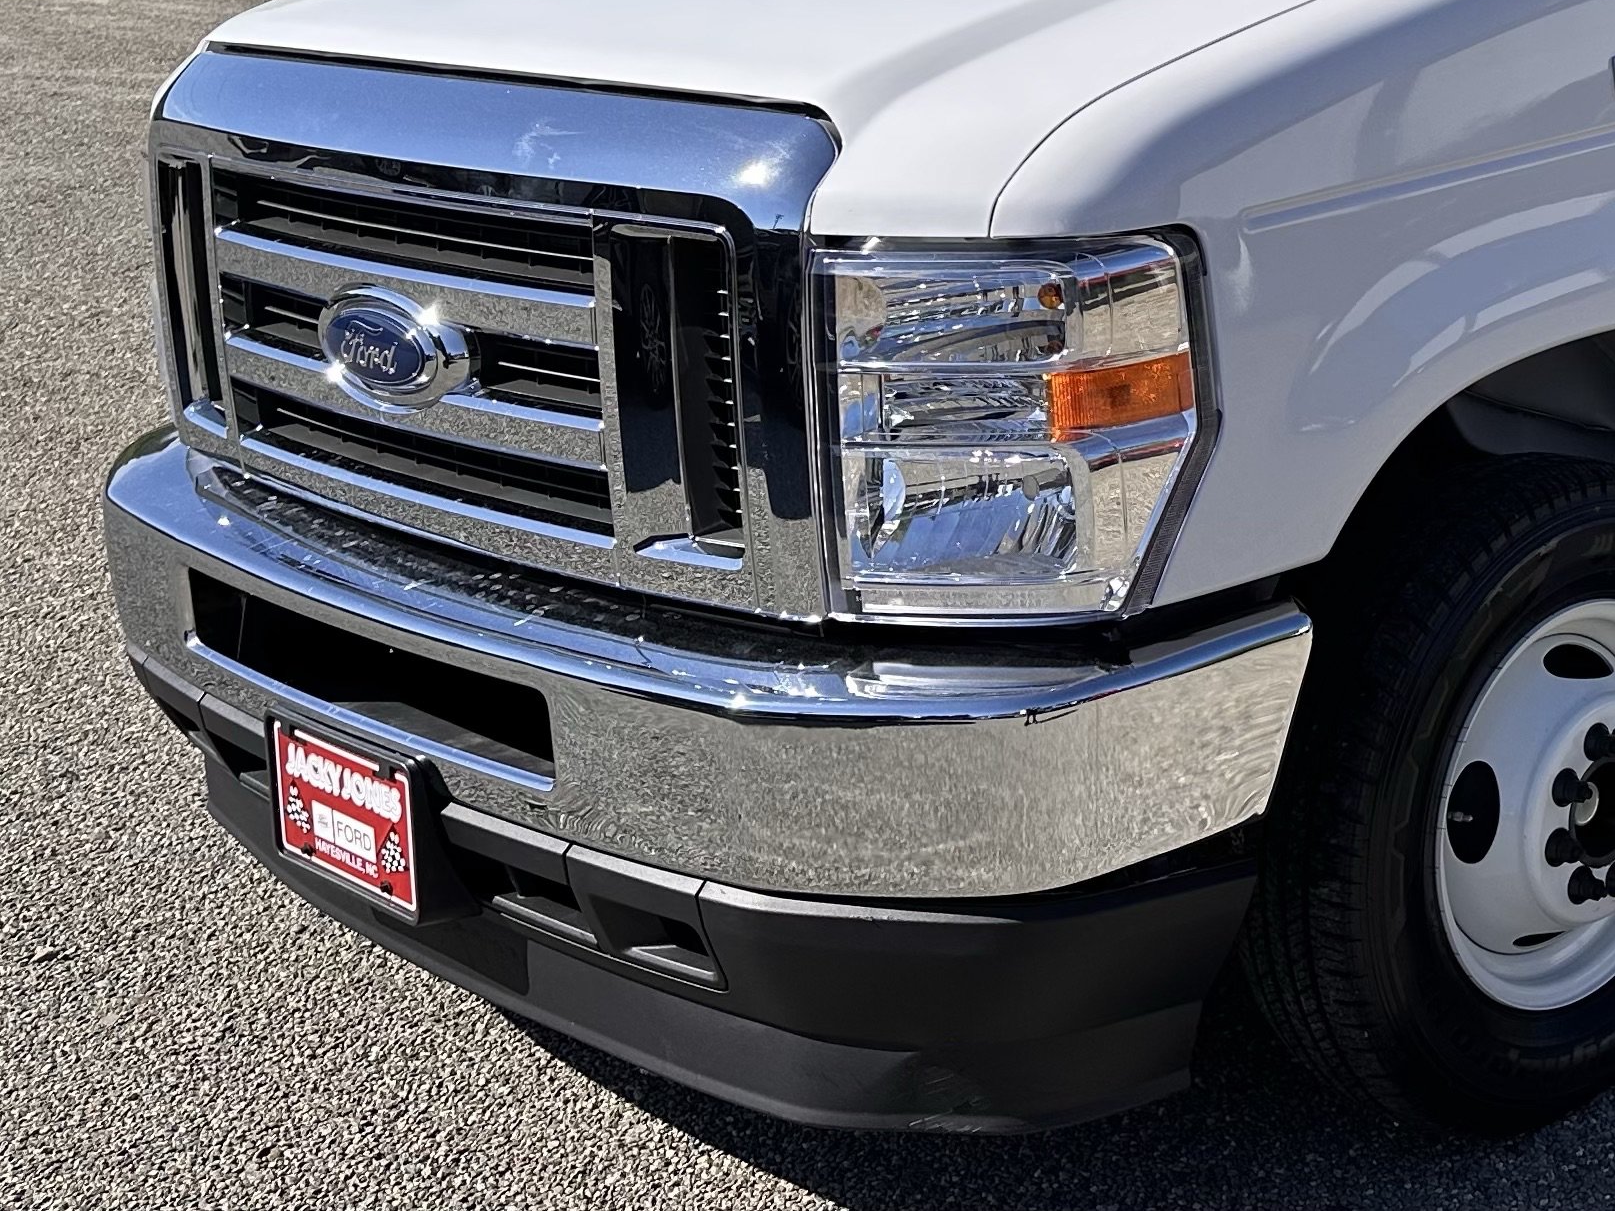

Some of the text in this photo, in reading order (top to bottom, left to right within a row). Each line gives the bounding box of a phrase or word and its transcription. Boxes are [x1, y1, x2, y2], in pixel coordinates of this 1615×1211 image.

[340, 320, 399, 375] Ford
[285, 742, 402, 823] JACKY JONES
[337, 820, 372, 851] FORD
[365, 861, 379, 879] NC
